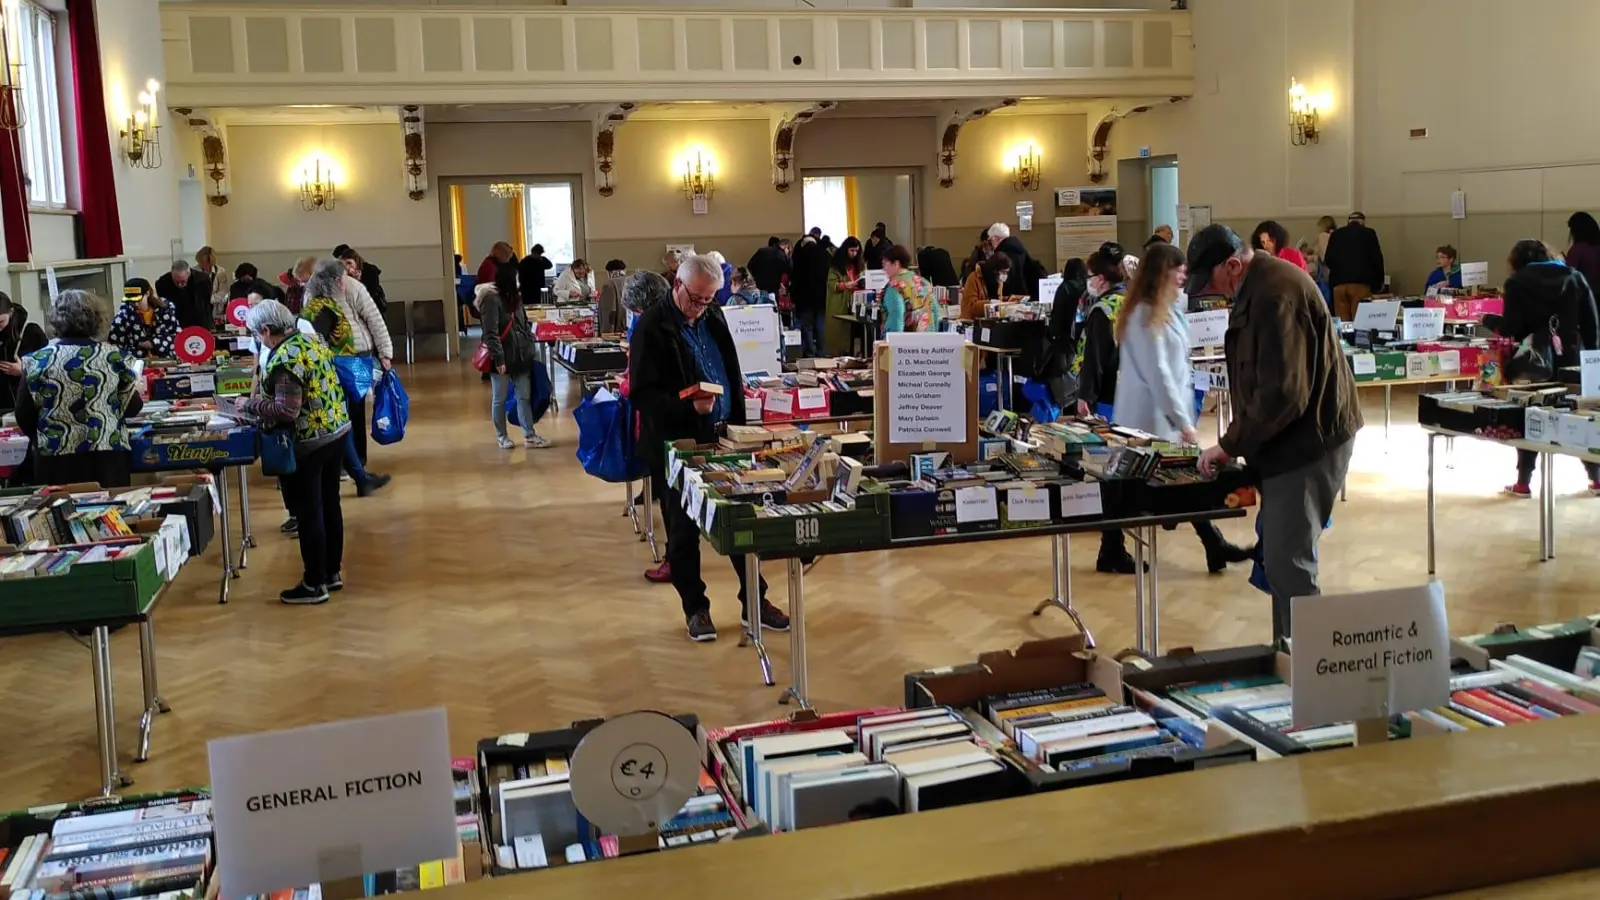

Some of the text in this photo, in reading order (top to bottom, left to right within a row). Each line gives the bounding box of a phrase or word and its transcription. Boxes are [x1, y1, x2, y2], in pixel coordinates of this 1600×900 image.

[921, 347, 929, 355] by
[1332, 621, 1419, 647] Romantic &
[1316, 648, 1433, 675] General Fiction
[620, 759, 655, 779] €4
[246, 770, 422, 812] GENERAL FICTION
